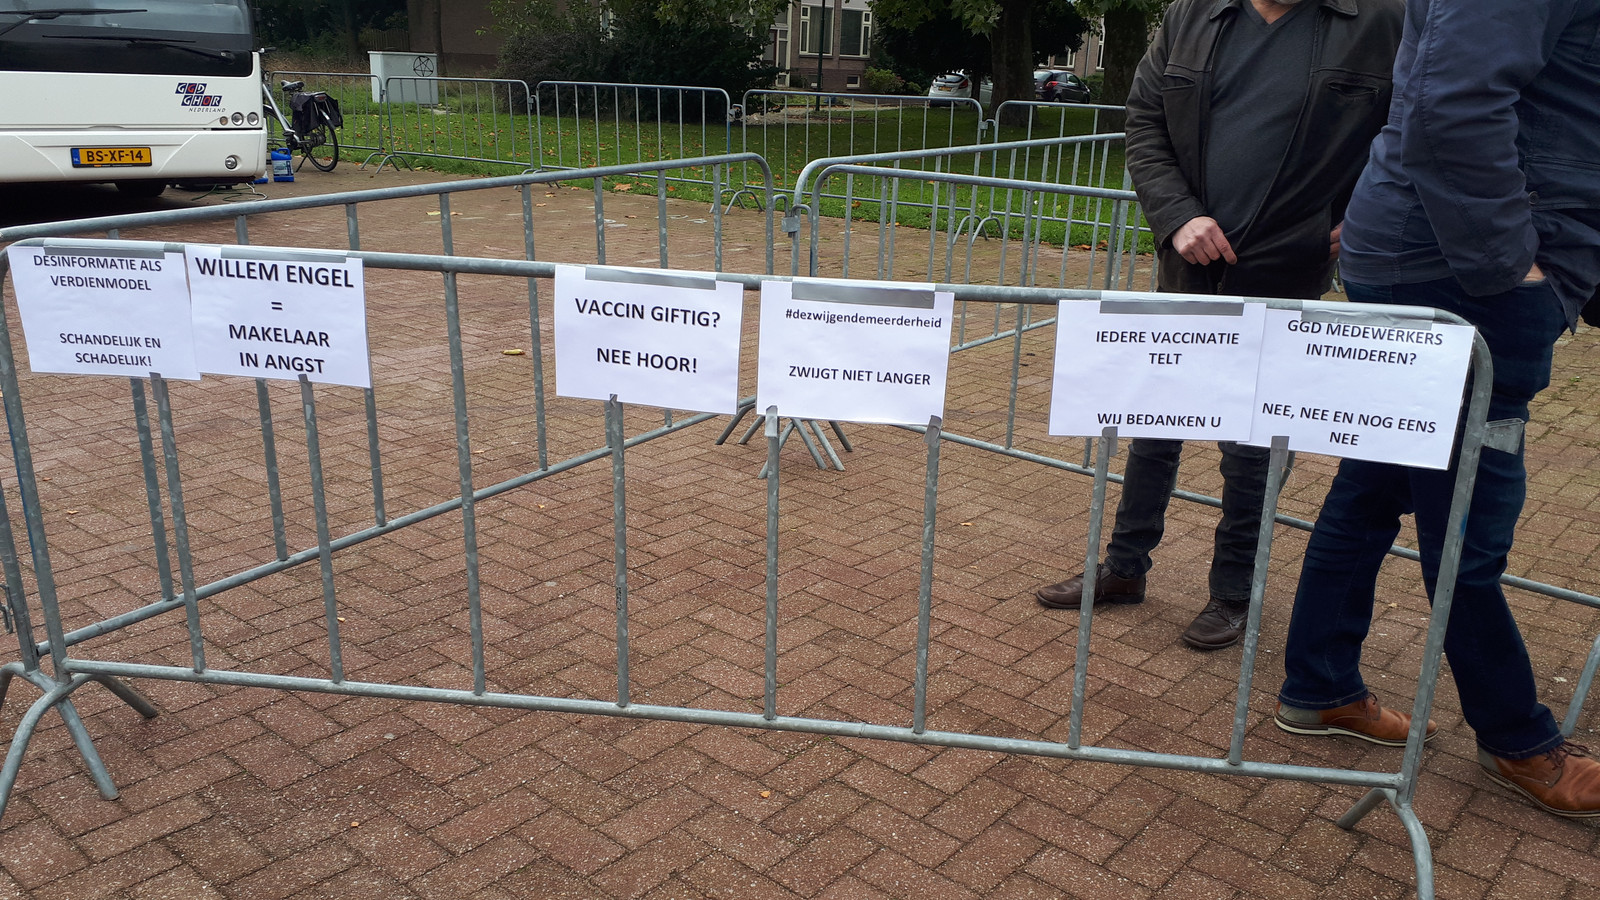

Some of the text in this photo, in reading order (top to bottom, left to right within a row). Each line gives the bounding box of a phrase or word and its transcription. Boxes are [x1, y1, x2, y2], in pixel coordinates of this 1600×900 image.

[175, 83, 206, 94] GGD
[182, 95, 221, 106] GHOR
[86, 150, 144, 162] BS-XF-14
[33, 255, 162, 272] DESINFORMATIE ALS
[195, 257, 354, 288] WILLEM ENGEL
[50, 275, 152, 291] VERDIENMODEL
[271, 301, 283, 311] =
[575, 298, 721, 328] VACCIN GIFTIG?
[785, 308, 942, 328] #dezwijgendemeerderheid
[229, 324, 331, 348] MAKELAAR
[1096, 331, 1240, 345] IEDERE VACCINATIE
[1287, 319, 1444, 346] GGD MEDEWERKERS
[59, 333, 162, 349] SCHANDELIJK EN
[75, 352, 152, 367] SCHADELIJK!
[597, 348, 697, 374] NEE HOOR!
[1149, 352, 1183, 365] TELT
[1306, 343, 1417, 366] INTIMIDEREN?
[239, 352, 325, 374] IN ANGST
[789, 365, 931, 386] ZWIJGT NIET LANGER
[1097, 412, 1222, 428] WIJ BEDANKEN U
[1262, 402, 1437, 434] NEE, NEE EN NOG EENS
[1329, 431, 1360, 446] NEE
